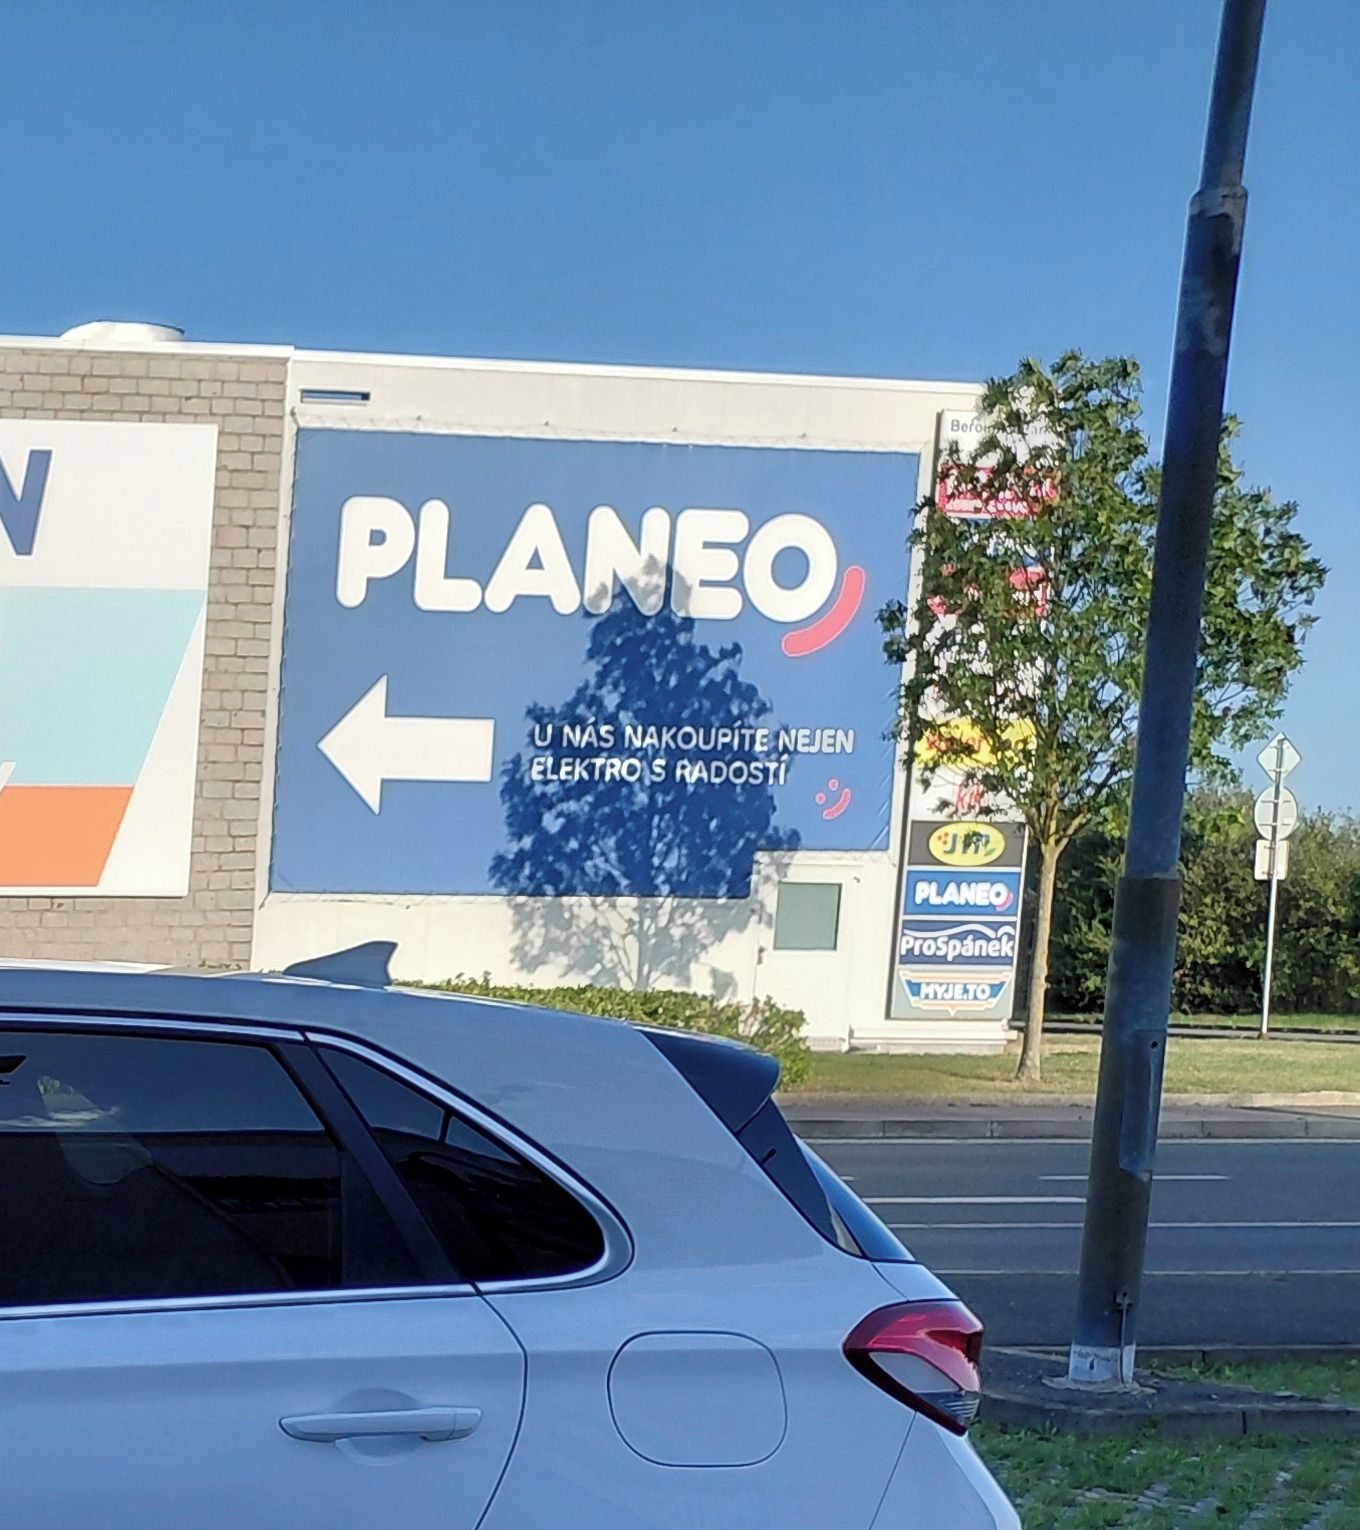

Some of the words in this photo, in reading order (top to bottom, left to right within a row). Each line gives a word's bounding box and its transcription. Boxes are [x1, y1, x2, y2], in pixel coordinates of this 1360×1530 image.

[335, 495, 838, 622] PLANEO
[533, 723, 553, 748] U
[562, 716, 615, 749] NÁS
[624, 720, 770, 753] NAKOUPÍTE
[778, 727, 855, 754] NEJEN
[531, 756, 641, 782] ELEKTRO
[649, 758, 666, 783] S
[675, 753, 788, 785] RADOSTÍ
[914, 881, 1008, 906] PLANEO
[900, 934, 1014, 962] ProSpánek
[920, 982, 991, 1001] MYJE.TO
